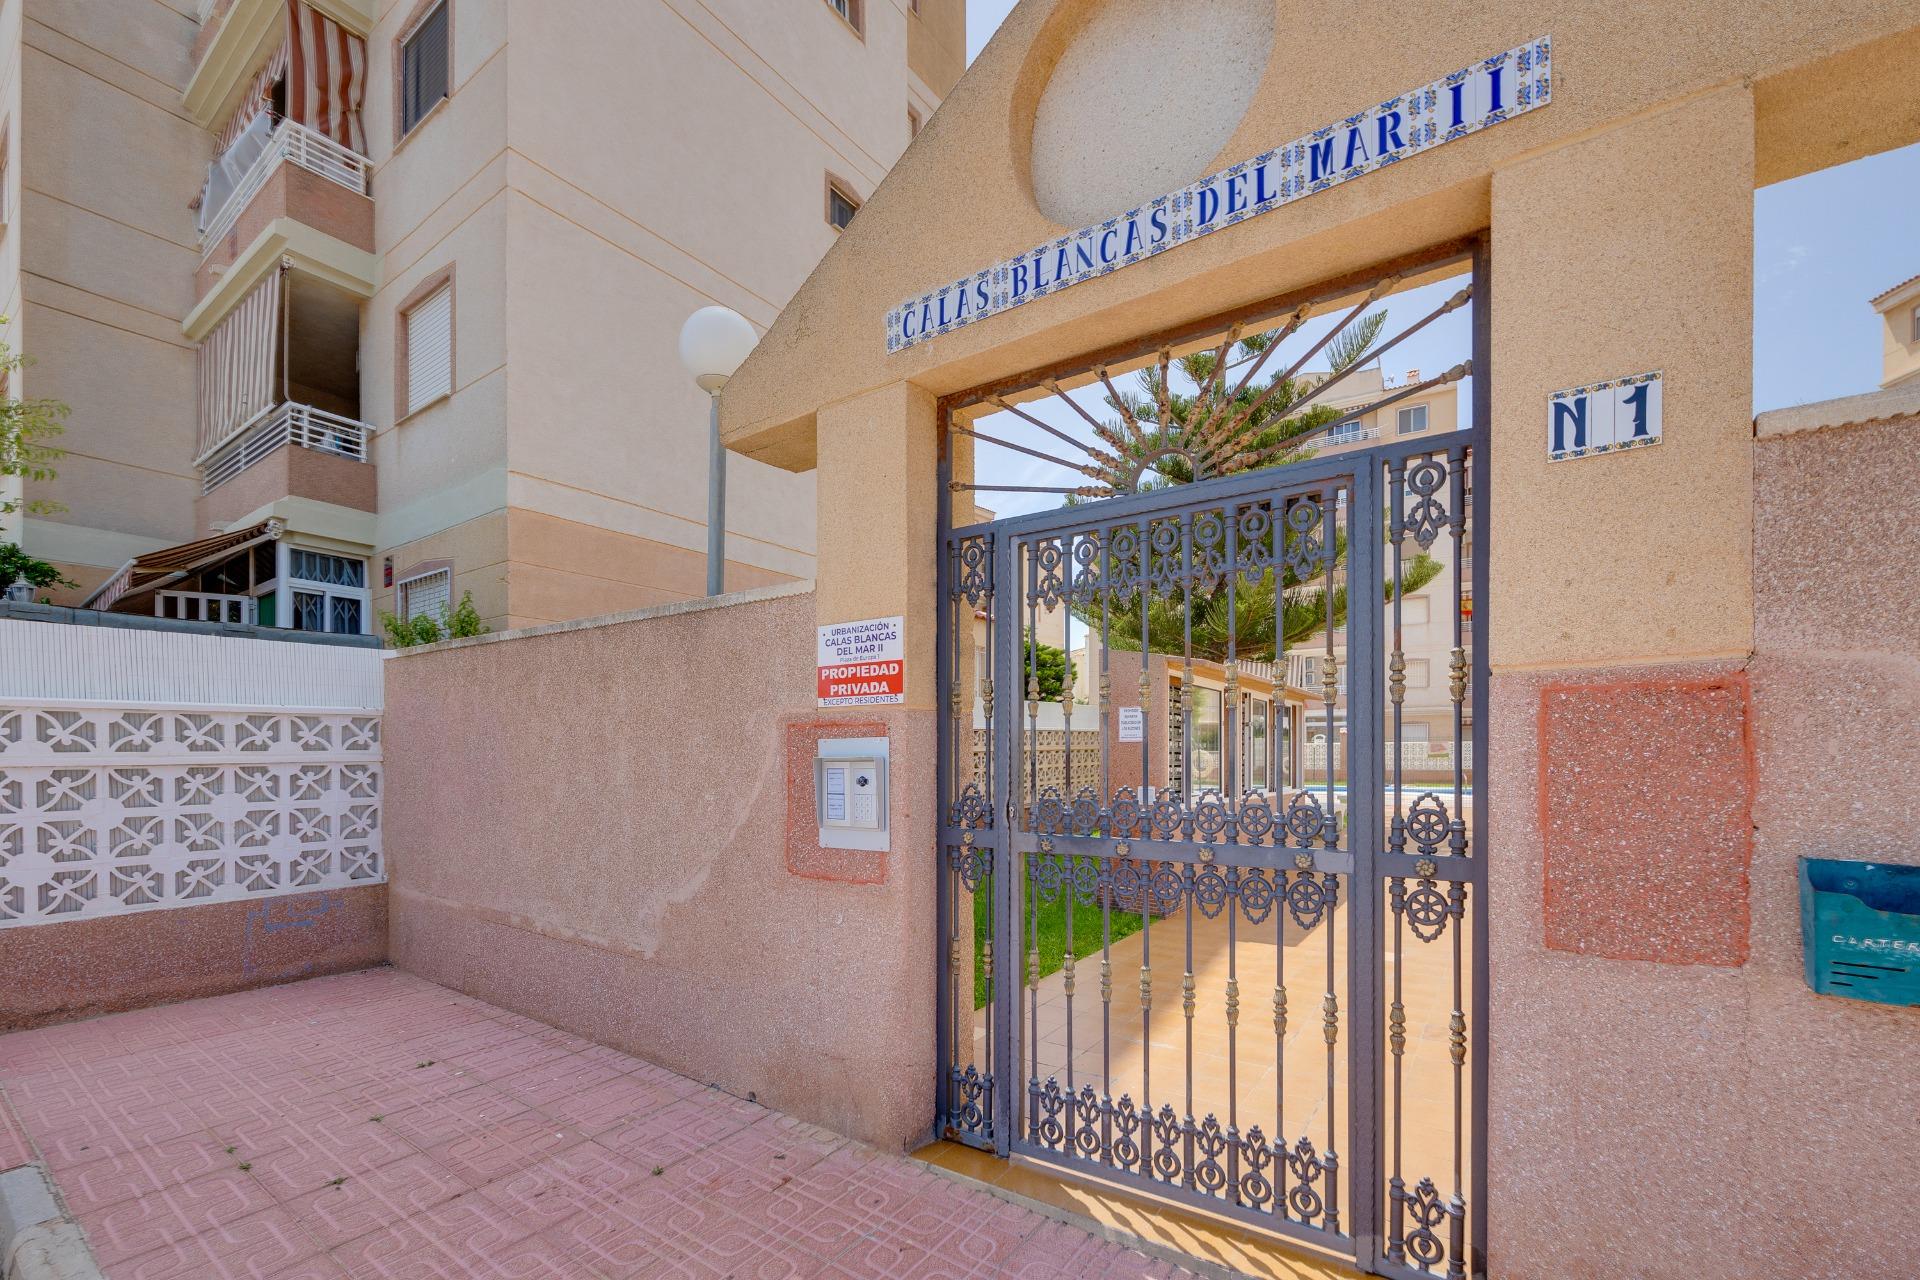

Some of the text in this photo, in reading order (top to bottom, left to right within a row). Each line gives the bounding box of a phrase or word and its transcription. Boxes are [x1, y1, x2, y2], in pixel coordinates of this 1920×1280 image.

[902, 66, 1505, 338] CALAS BLANCAS DEL MAR II
[1552, 383, 1649, 452] N 1
[831, 622, 889, 636] URBANIZACIÓN
[825, 631, 897, 647] CALAS BLANCAS
[837, 643, 883, 656] DEL MAR II
[821, 663, 899, 680] PROPIEDAD
[830, 681, 889, 695] PRIVADA
[823, 695, 899, 706] EXCEPTO RESIDENTES
